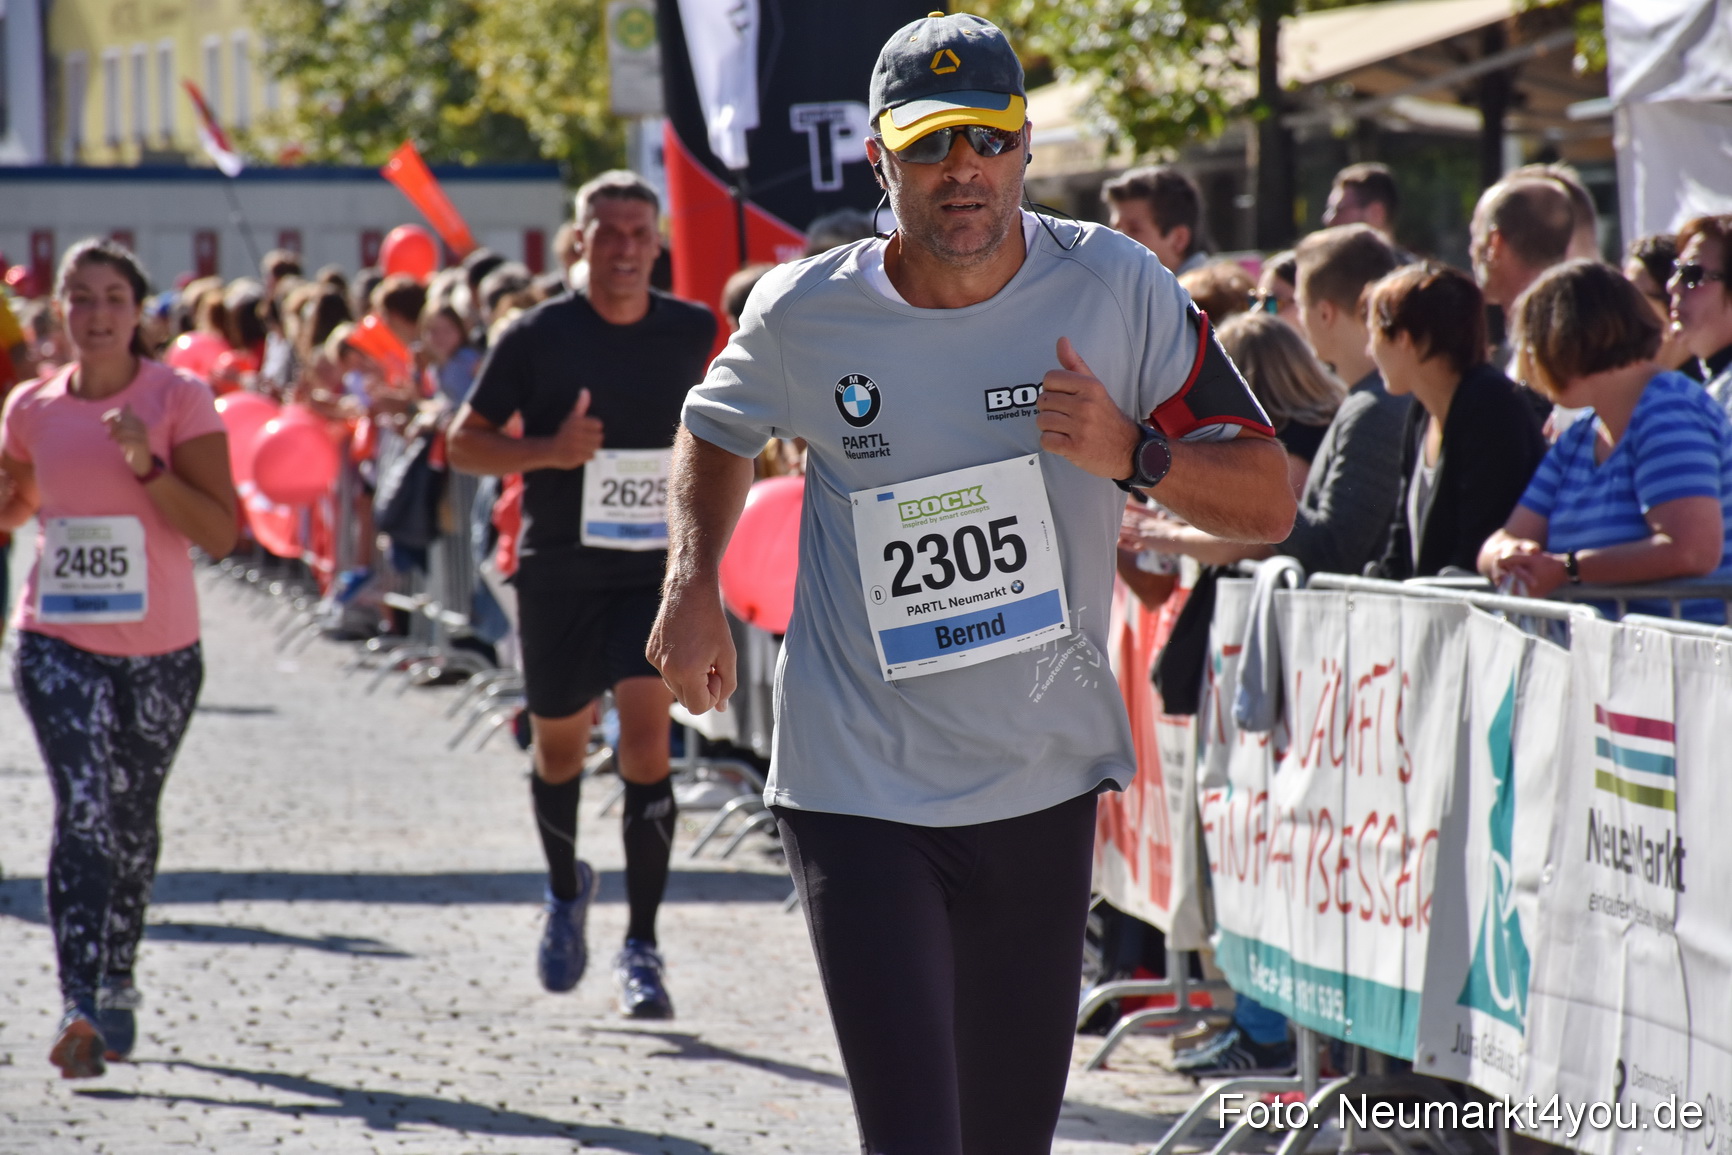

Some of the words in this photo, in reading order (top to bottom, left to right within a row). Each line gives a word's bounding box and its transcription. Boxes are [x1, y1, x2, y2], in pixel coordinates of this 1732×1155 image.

[836, 375, 876, 394] BMW
[987, 409, 1020, 421] inspired
[1021, 408, 1031, 418] by
[842, 433, 889, 449] PARTL
[844, 447, 891, 460] Neumarkt
[601, 478, 667, 508] 2625
[898, 485, 988, 522] BOCK
[902, 518, 928, 530] inspired
[929, 516, 938, 524] by
[939, 512, 959, 522] smart
[960, 504, 990, 518] concepts
[55, 546, 129, 578] 2485
[883, 515, 1027, 598] 2305
[906, 600, 947, 616] PARTL
[949, 586, 1008, 607] Neumarkt
[934, 612, 1006, 650] Bernd
[1041, 645, 1076, 691] September
